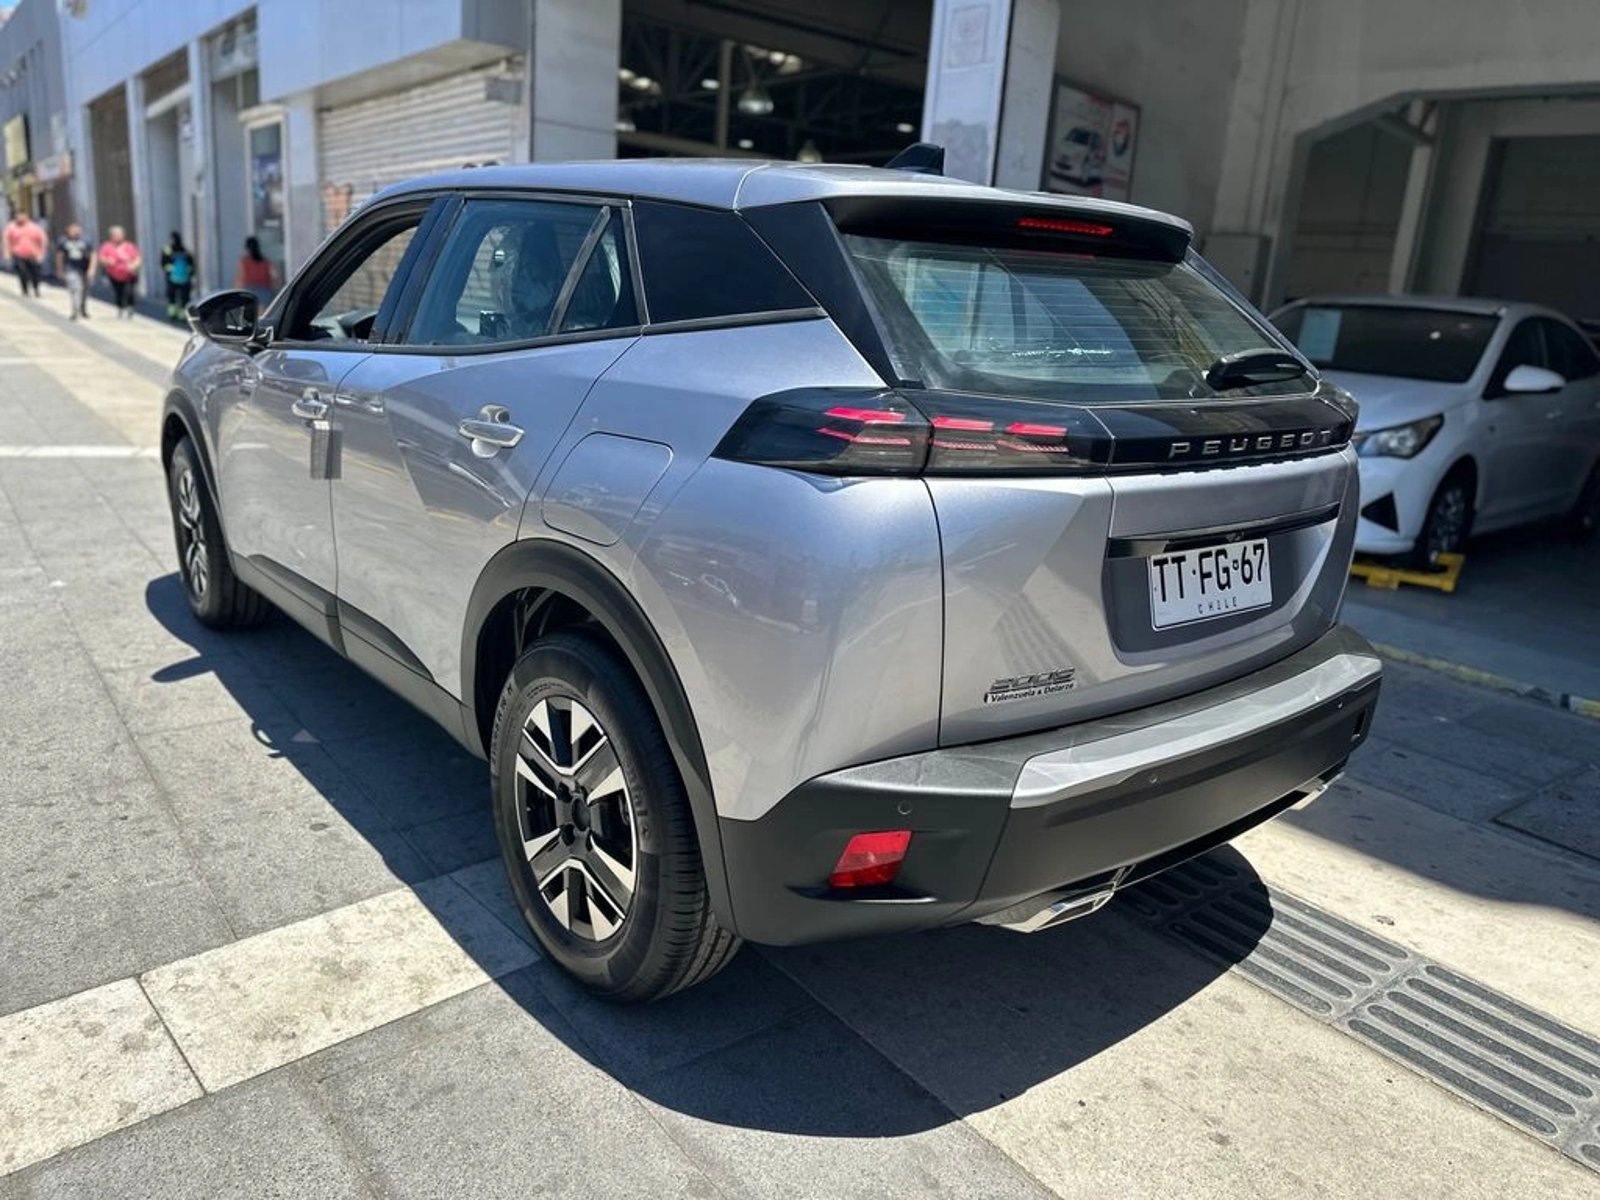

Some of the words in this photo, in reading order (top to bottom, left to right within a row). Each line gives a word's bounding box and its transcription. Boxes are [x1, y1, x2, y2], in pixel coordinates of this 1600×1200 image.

[1169, 430, 1331, 457] PEUGEOT
[1198, 597, 1237, 614] CHILE
[992, 690, 1035, 702] Valenzuela
